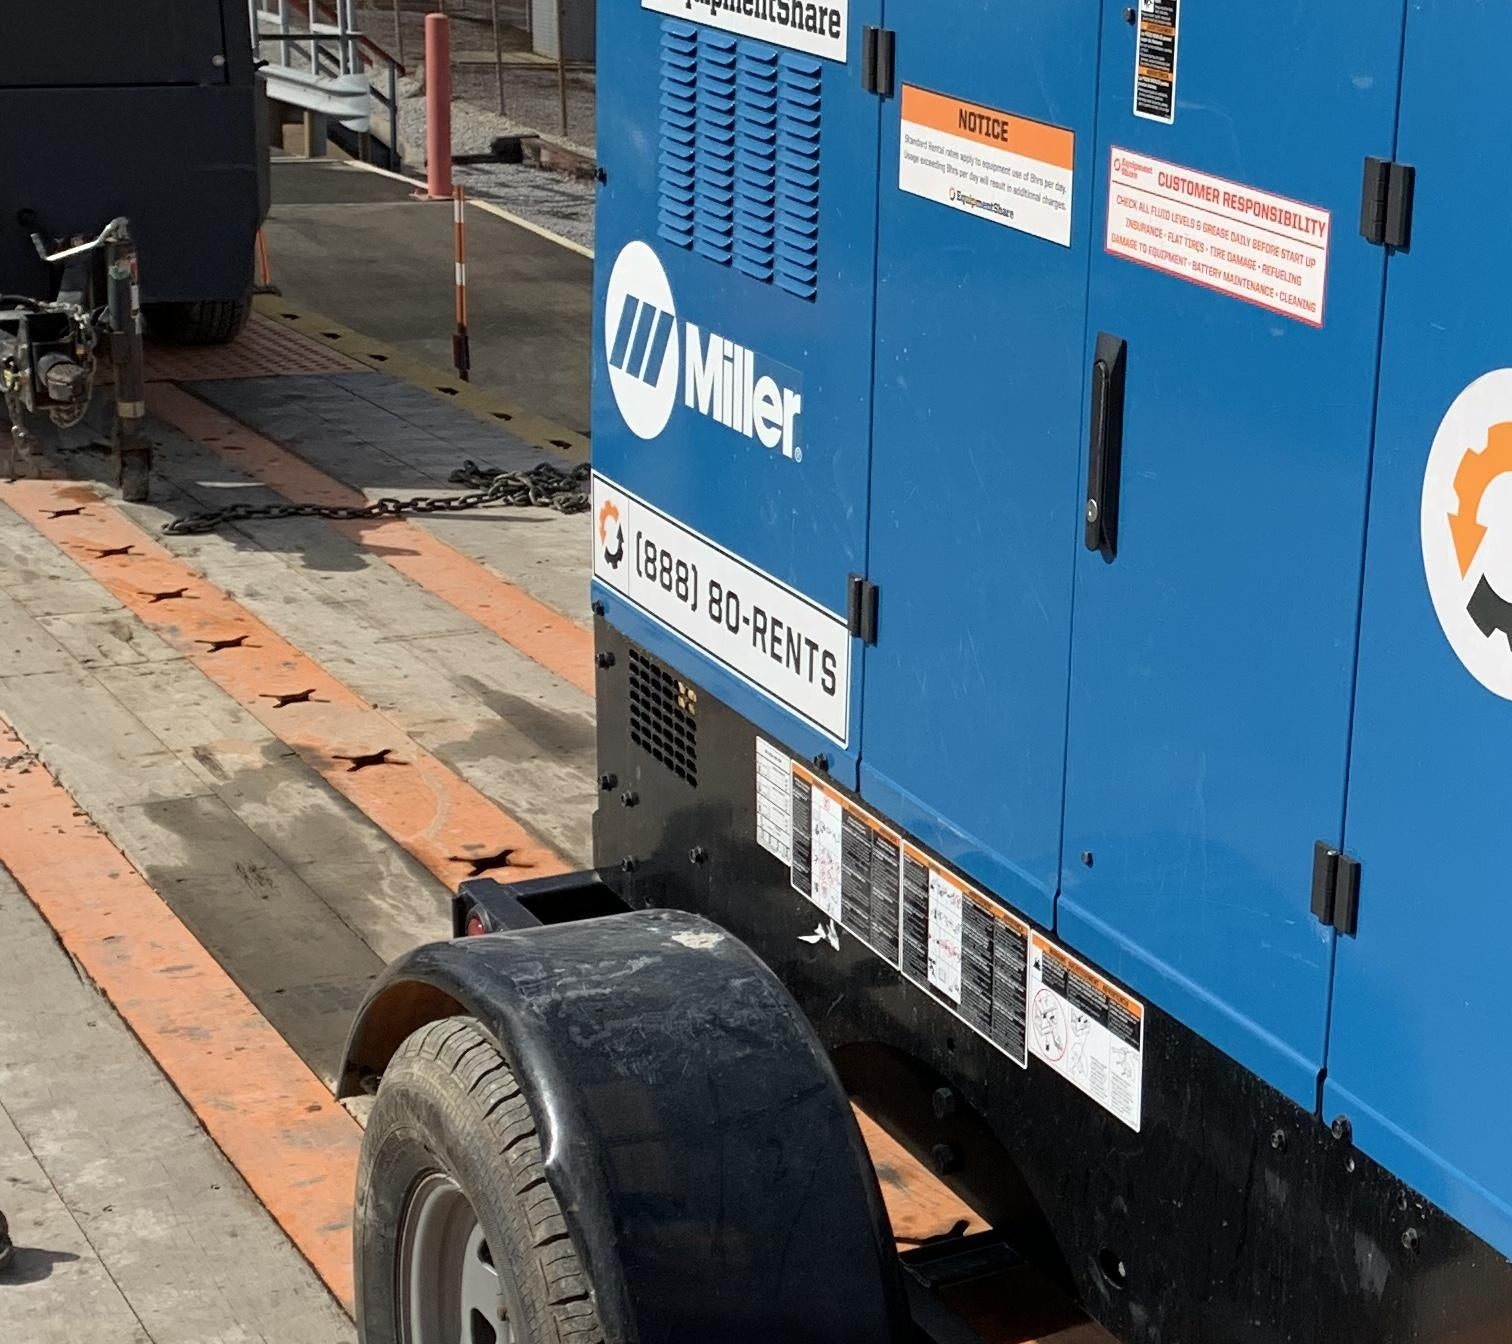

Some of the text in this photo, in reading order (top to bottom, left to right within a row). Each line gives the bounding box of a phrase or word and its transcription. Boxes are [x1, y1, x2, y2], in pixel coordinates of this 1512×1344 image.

[958, 109, 1009, 142] NOTICE
[904, 134, 928, 149] Standard
[960, 153, 974, 166] apply
[982, 160, 1011, 176] equipment
[1012, 170, 1022, 179] use
[1023, 171, 1029, 181] of
[1044, 179, 1054, 189] per
[920, 157, 945, 174] exceeding
[959, 169, 968, 179] per
[969, 171, 978, 184] day
[979, 175, 989, 186] will
[989, 179, 1005, 192] result
[1013, 187, 1041, 202] additional
[1121, 158, 1153, 174] Equipment
[1121, 167, 1138, 179] Share
[957, 191, 1014, 219] EquipmentShare
[1116, 194, 1137, 211] CHECK
[1138, 202, 1150, 214] ALL
[1151, 205, 1170, 221] FLUID
[1171, 211, 1195, 229] LEVELS
[1202, 221, 1229, 241] GREASE
[1230, 231, 1250, 247] DAILY
[1252, 238, 1280, 257] BEFORE
[1281, 248, 1304, 265] START
[1305, 255, 1316, 269] UP
[1158, 171, 1326, 238] CUSTOMER RESPONSIBILITY
[1111, 232, 1317, 313] DAMAGE TO EQUIPMENT BATTERY MAINTENANCE CLEANING
[1125, 217, 1302, 286] INSURANCE FLAT TIRES TIRE DAMAGE REFUELING
[635, 530, 837, 697] (888) 80-RENTS
